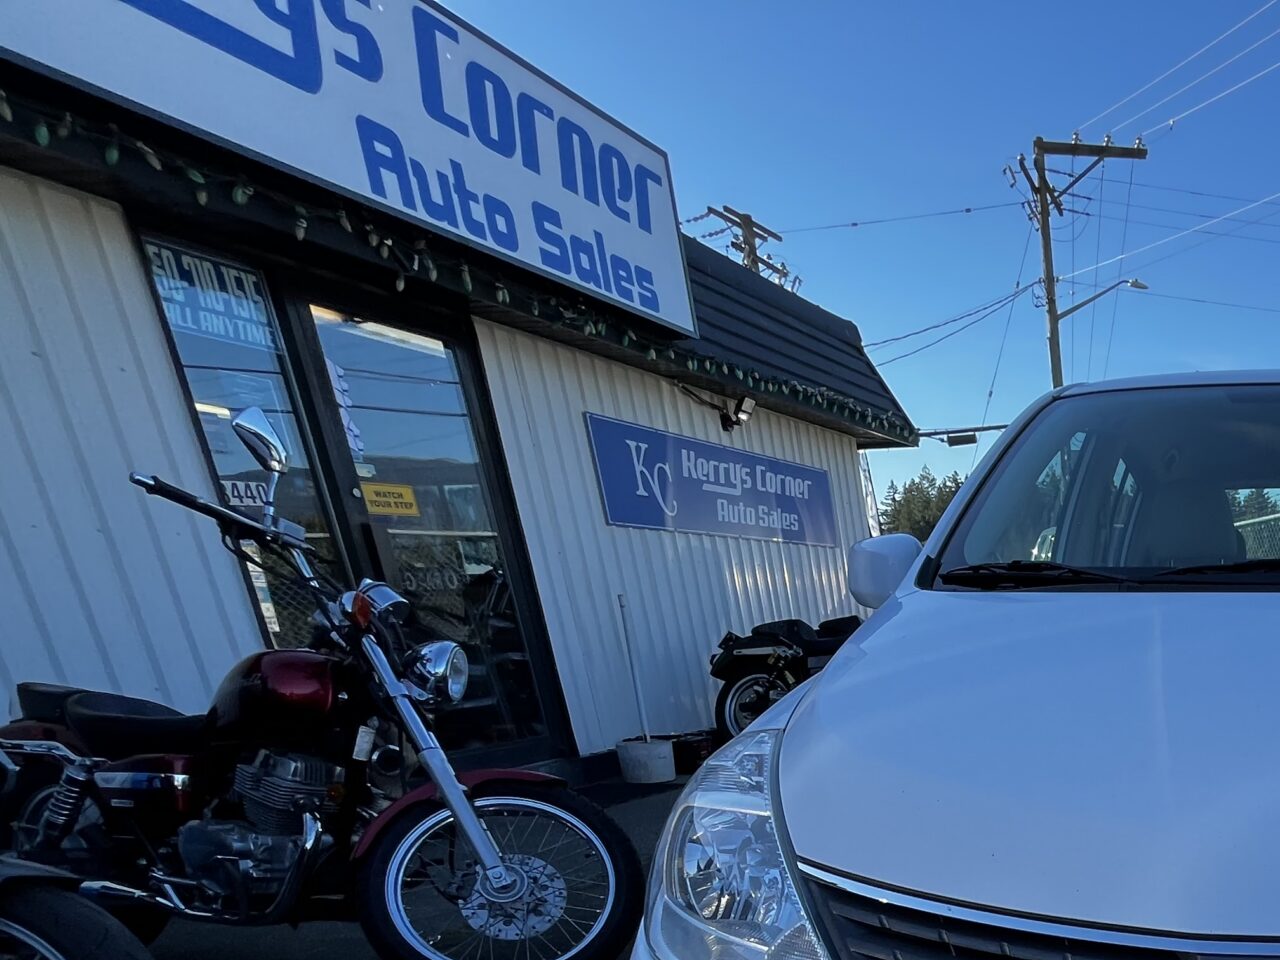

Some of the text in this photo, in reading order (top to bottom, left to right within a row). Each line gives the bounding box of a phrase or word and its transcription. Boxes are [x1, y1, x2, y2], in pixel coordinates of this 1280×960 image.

[412, 5, 662, 235] Corner
[355, 114, 660, 313] Auto Sales
[199, 310, 275, 347] ANYTIME
[373, 490, 404, 499] WATCH
[756, 465, 812, 499] Corner
[368, 499, 414, 509] YOUR STEP
[717, 499, 799, 530] Auto Sales
